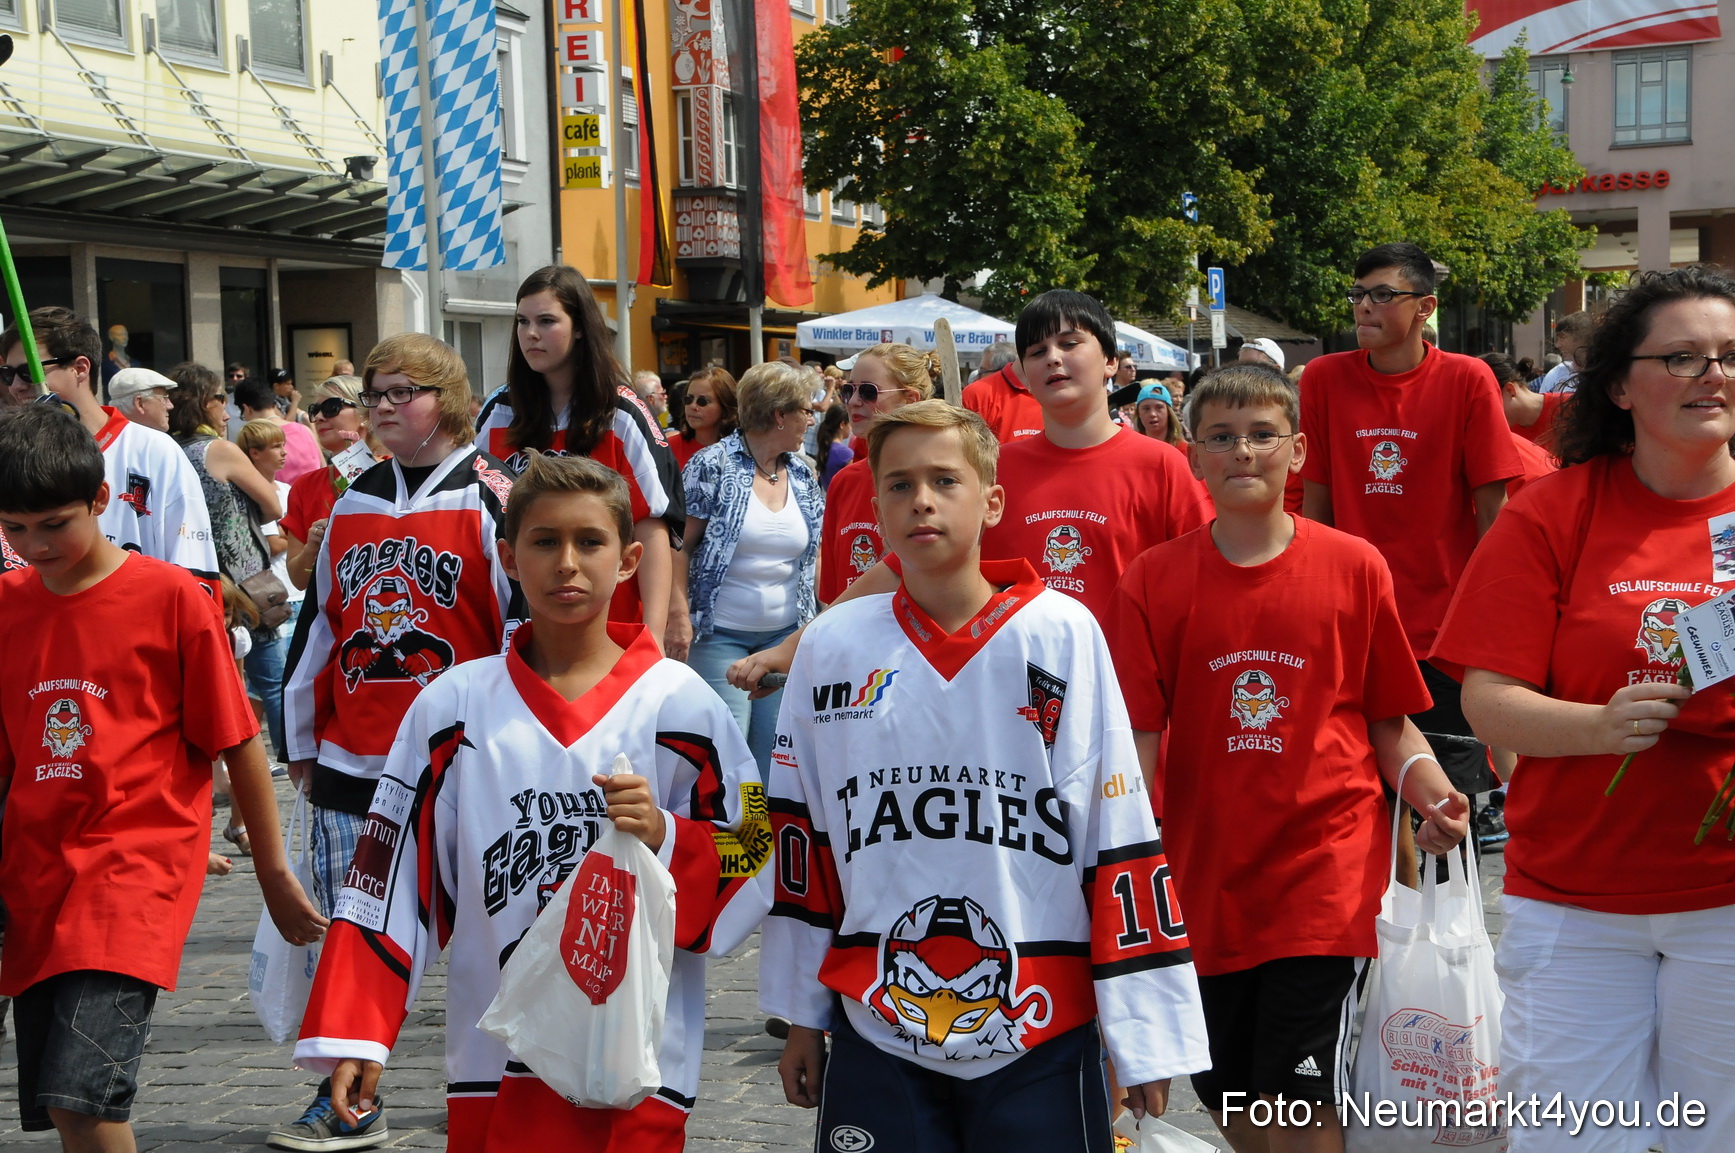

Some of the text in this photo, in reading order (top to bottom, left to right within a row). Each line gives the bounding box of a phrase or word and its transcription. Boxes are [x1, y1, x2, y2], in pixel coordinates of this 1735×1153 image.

[564, 118, 600, 142] café
[566, 161, 601, 185] plank
[1211, 273, 1222, 305] P
[812, 327, 879, 341] Winkler Bräu
[968, 332, 993, 345] Bräu
[1401, 429, 1419, 440] FELIX
[1365, 483, 1403, 495] EAGLES
[1025, 509, 1108, 525] EISLAUFSCHULE FELIX
[1608, 579, 1702, 596] EISLAUFSCHULE
[1714, 601, 1735, 638] EAGLES
[1208, 649, 1306, 671] EISLAUFSCHULE FELIX
[81, 680, 108, 700] FELIX
[1227, 736, 1283, 754] EAGLES
[35, 763, 83, 782] EAGLES
[868, 764, 1027, 793] NEUMARKT
[510, 787, 610, 830] Youn
[836, 774, 1074, 866] EAGLES
[1111, 863, 1188, 950] 10
[1294, 1067, 1322, 1077] adidas
[1391, 1058, 1439, 1079] Schön
[1442, 1070, 1458, 1086] ist
[1480, 1065, 1499, 1081] We
[1400, 1077, 1428, 1091] mit
